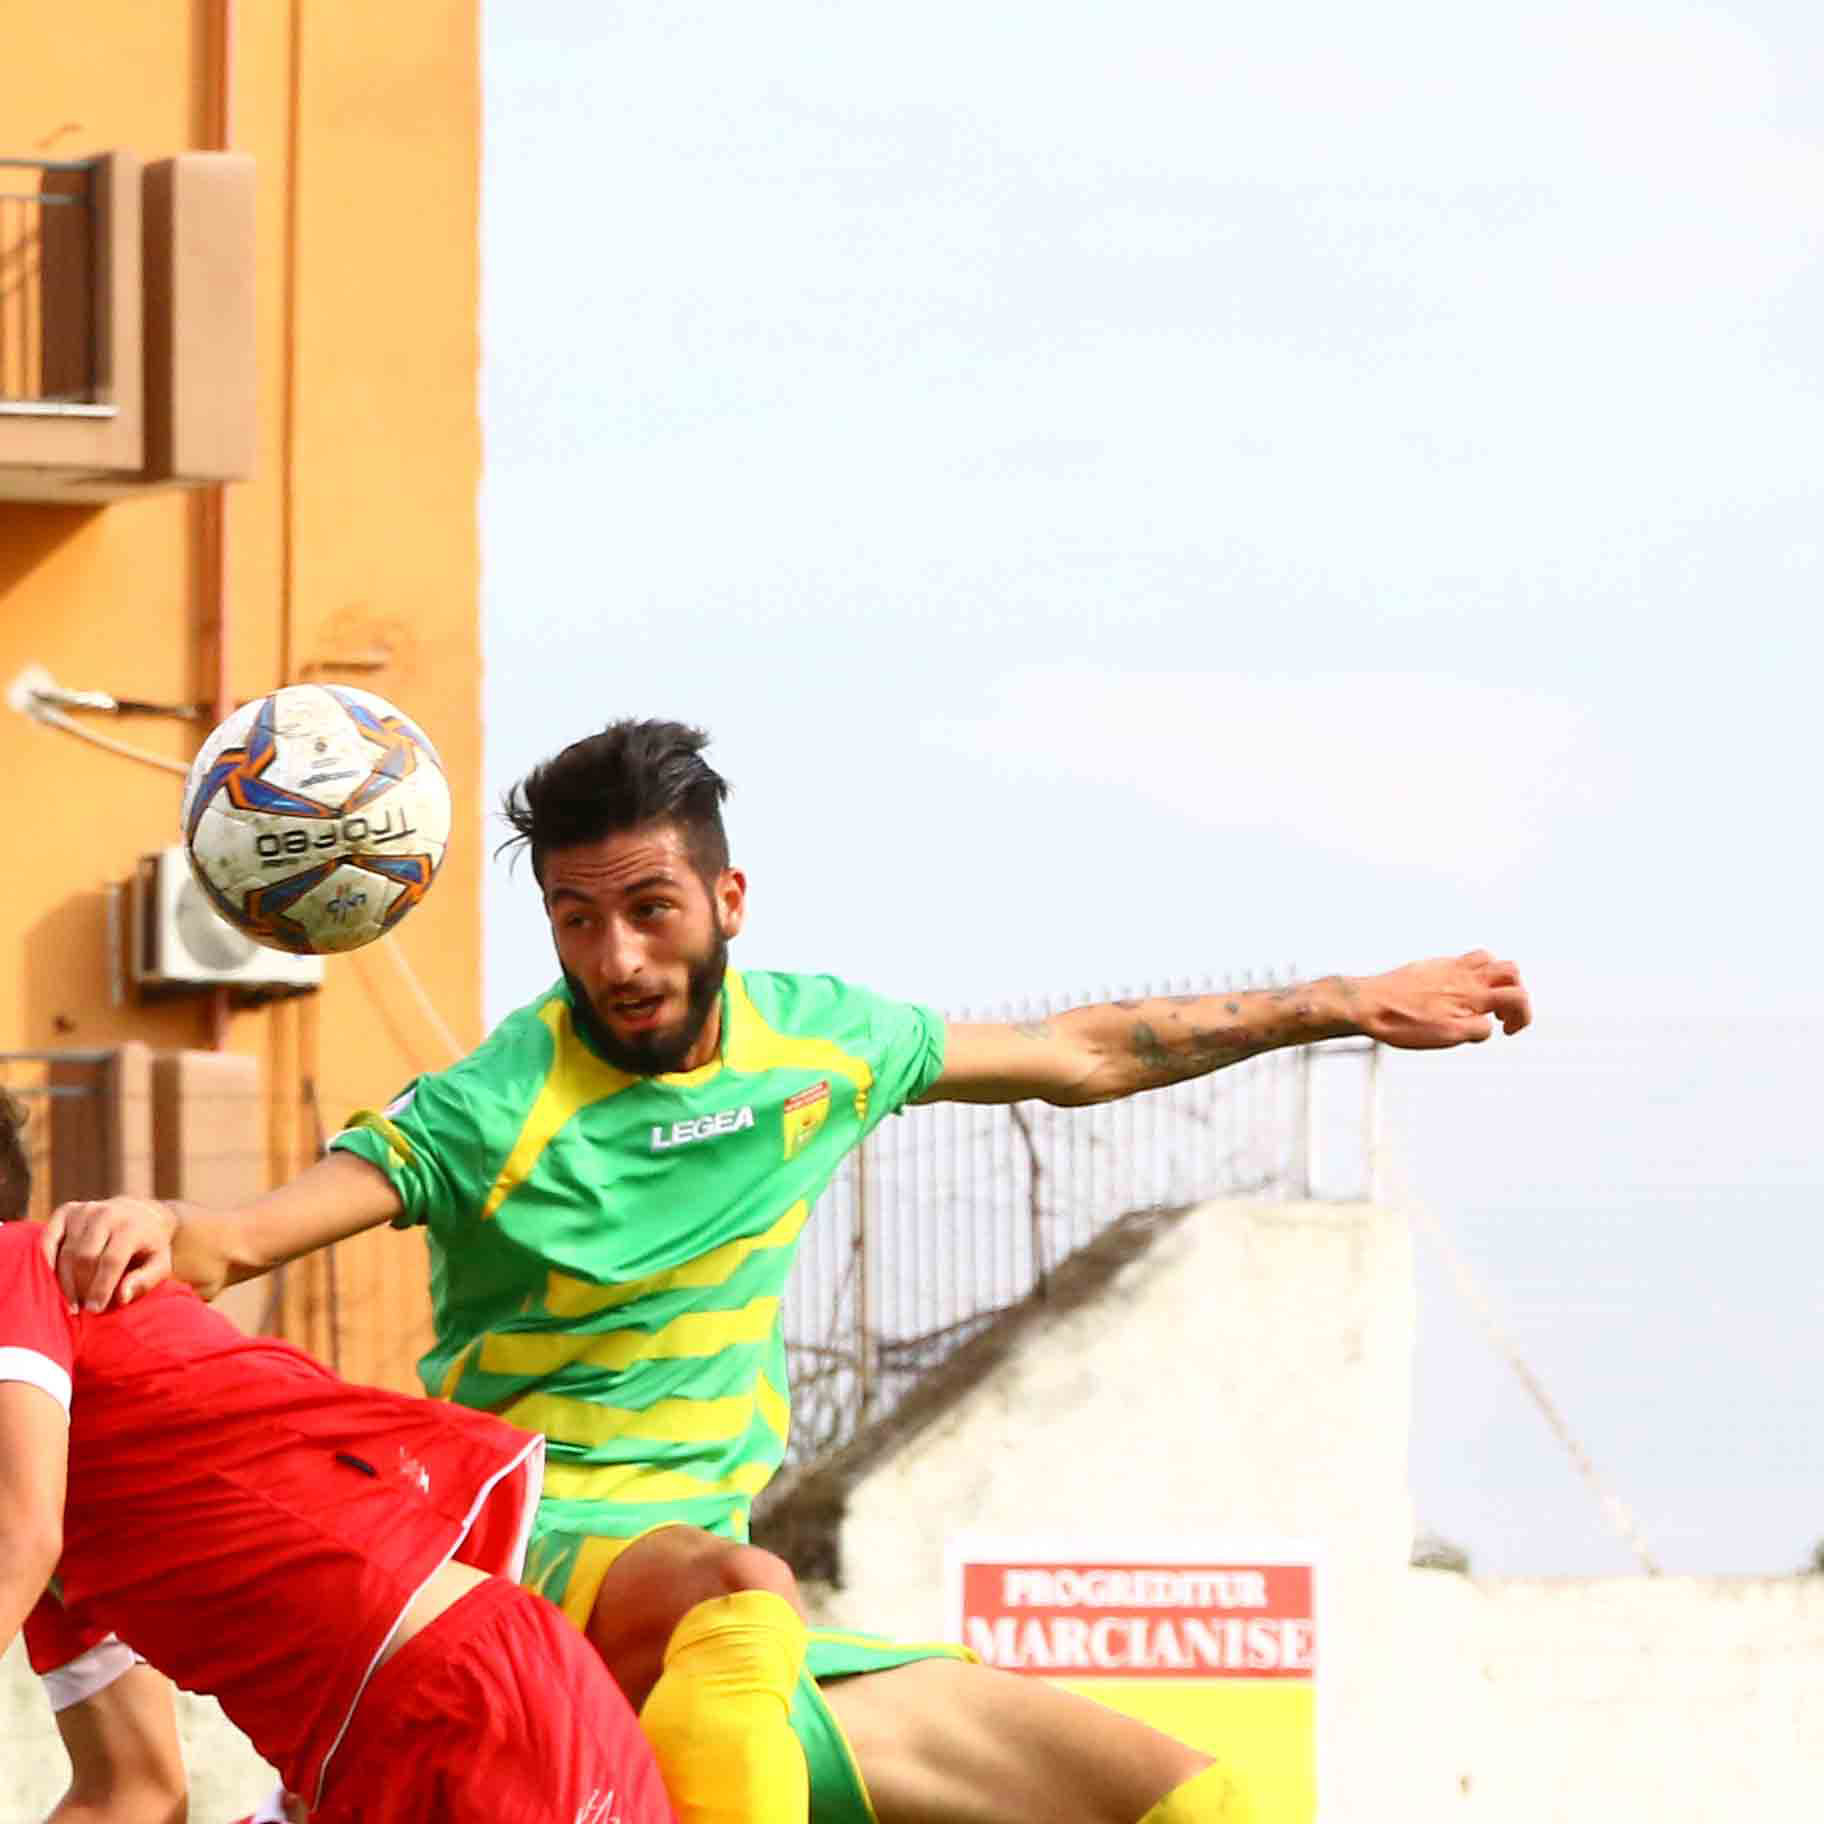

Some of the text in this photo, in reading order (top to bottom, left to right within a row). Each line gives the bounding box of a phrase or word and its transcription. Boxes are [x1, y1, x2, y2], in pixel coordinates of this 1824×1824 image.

[652, 1105, 754, 1151] LEGEA
[1004, 1568, 1268, 1608] PROGREDITUR
[967, 1616, 1316, 1669] MARCIANISE
